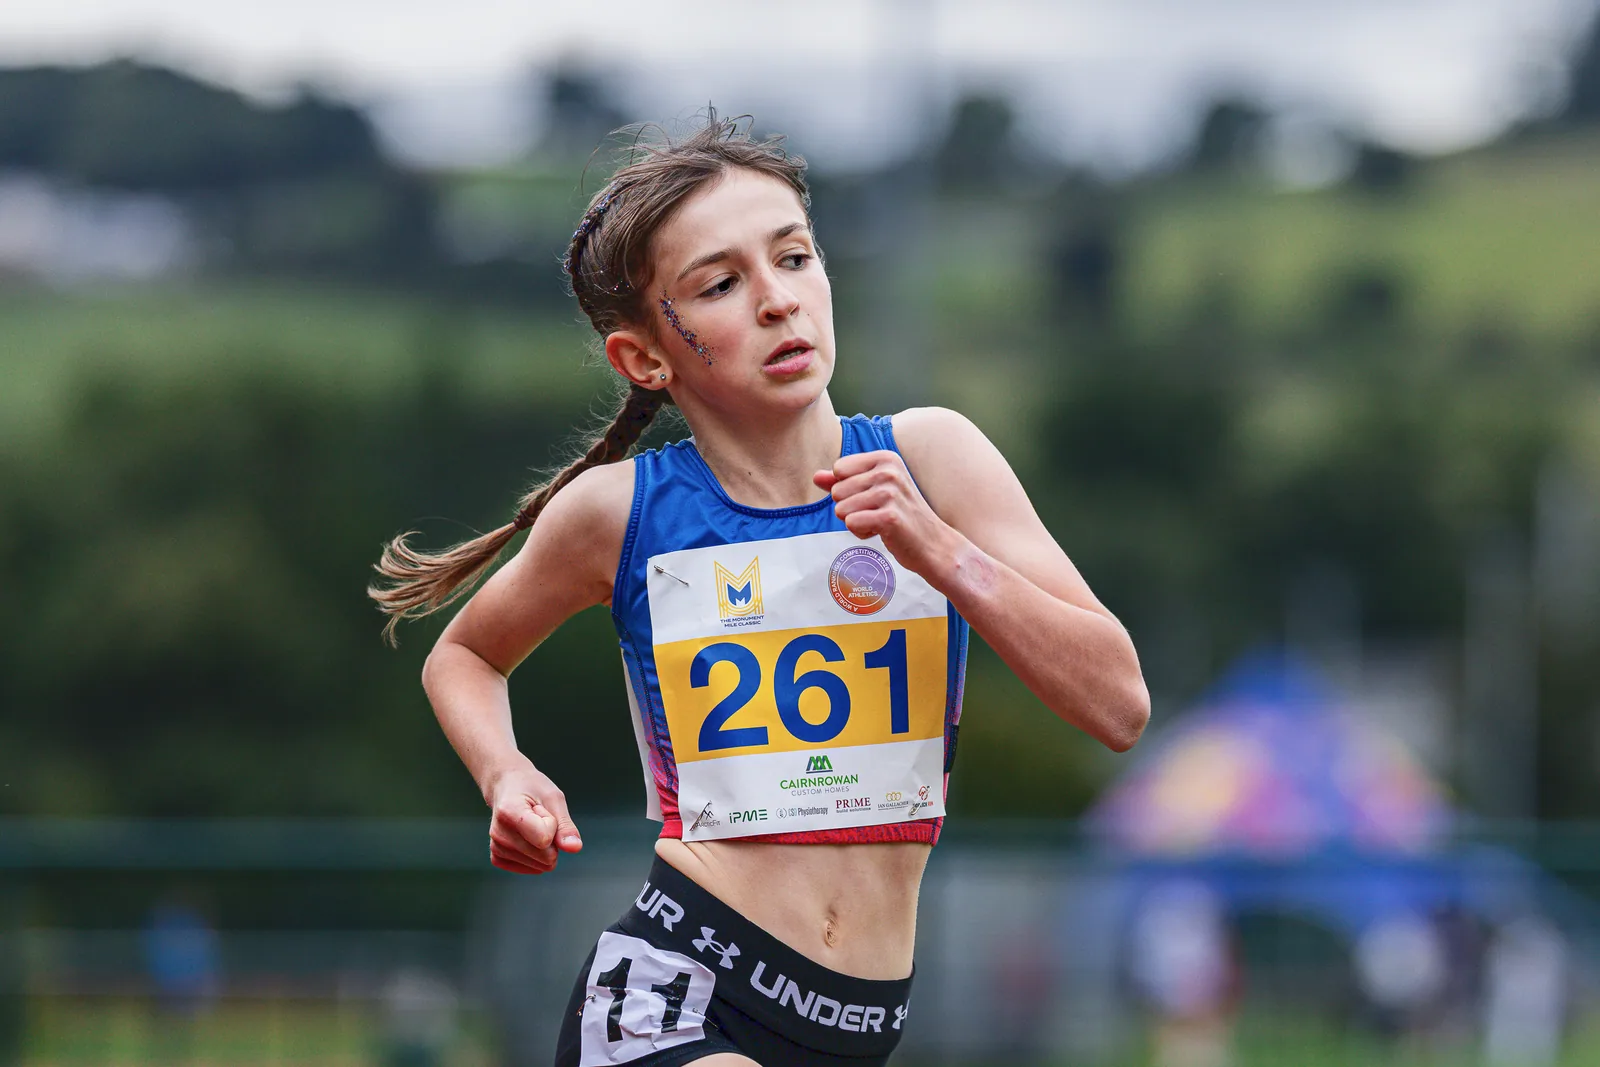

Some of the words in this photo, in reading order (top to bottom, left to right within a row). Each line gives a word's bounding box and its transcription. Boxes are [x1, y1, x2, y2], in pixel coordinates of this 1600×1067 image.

[839, 548, 879, 561] COMPETITION
[831, 561, 841, 593] RANKINGS
[834, 592, 853, 611] WORLD
[732, 615, 765, 623] MONUMENT
[690, 629, 910, 753] 261
[780, 774, 859, 790] CAIRNROWAN
[791, 788, 822, 797] CUSTOM
[825, 785, 850, 794] HOMES
[836, 797, 871, 809] PRIME
[885, 800, 909, 808] GALLACHER
[797, 806, 828, 818] Physiotherapy
[634, 880, 685, 932] UR
[597, 957, 692, 1043] 11
[750, 960, 886, 1033] UNDER
